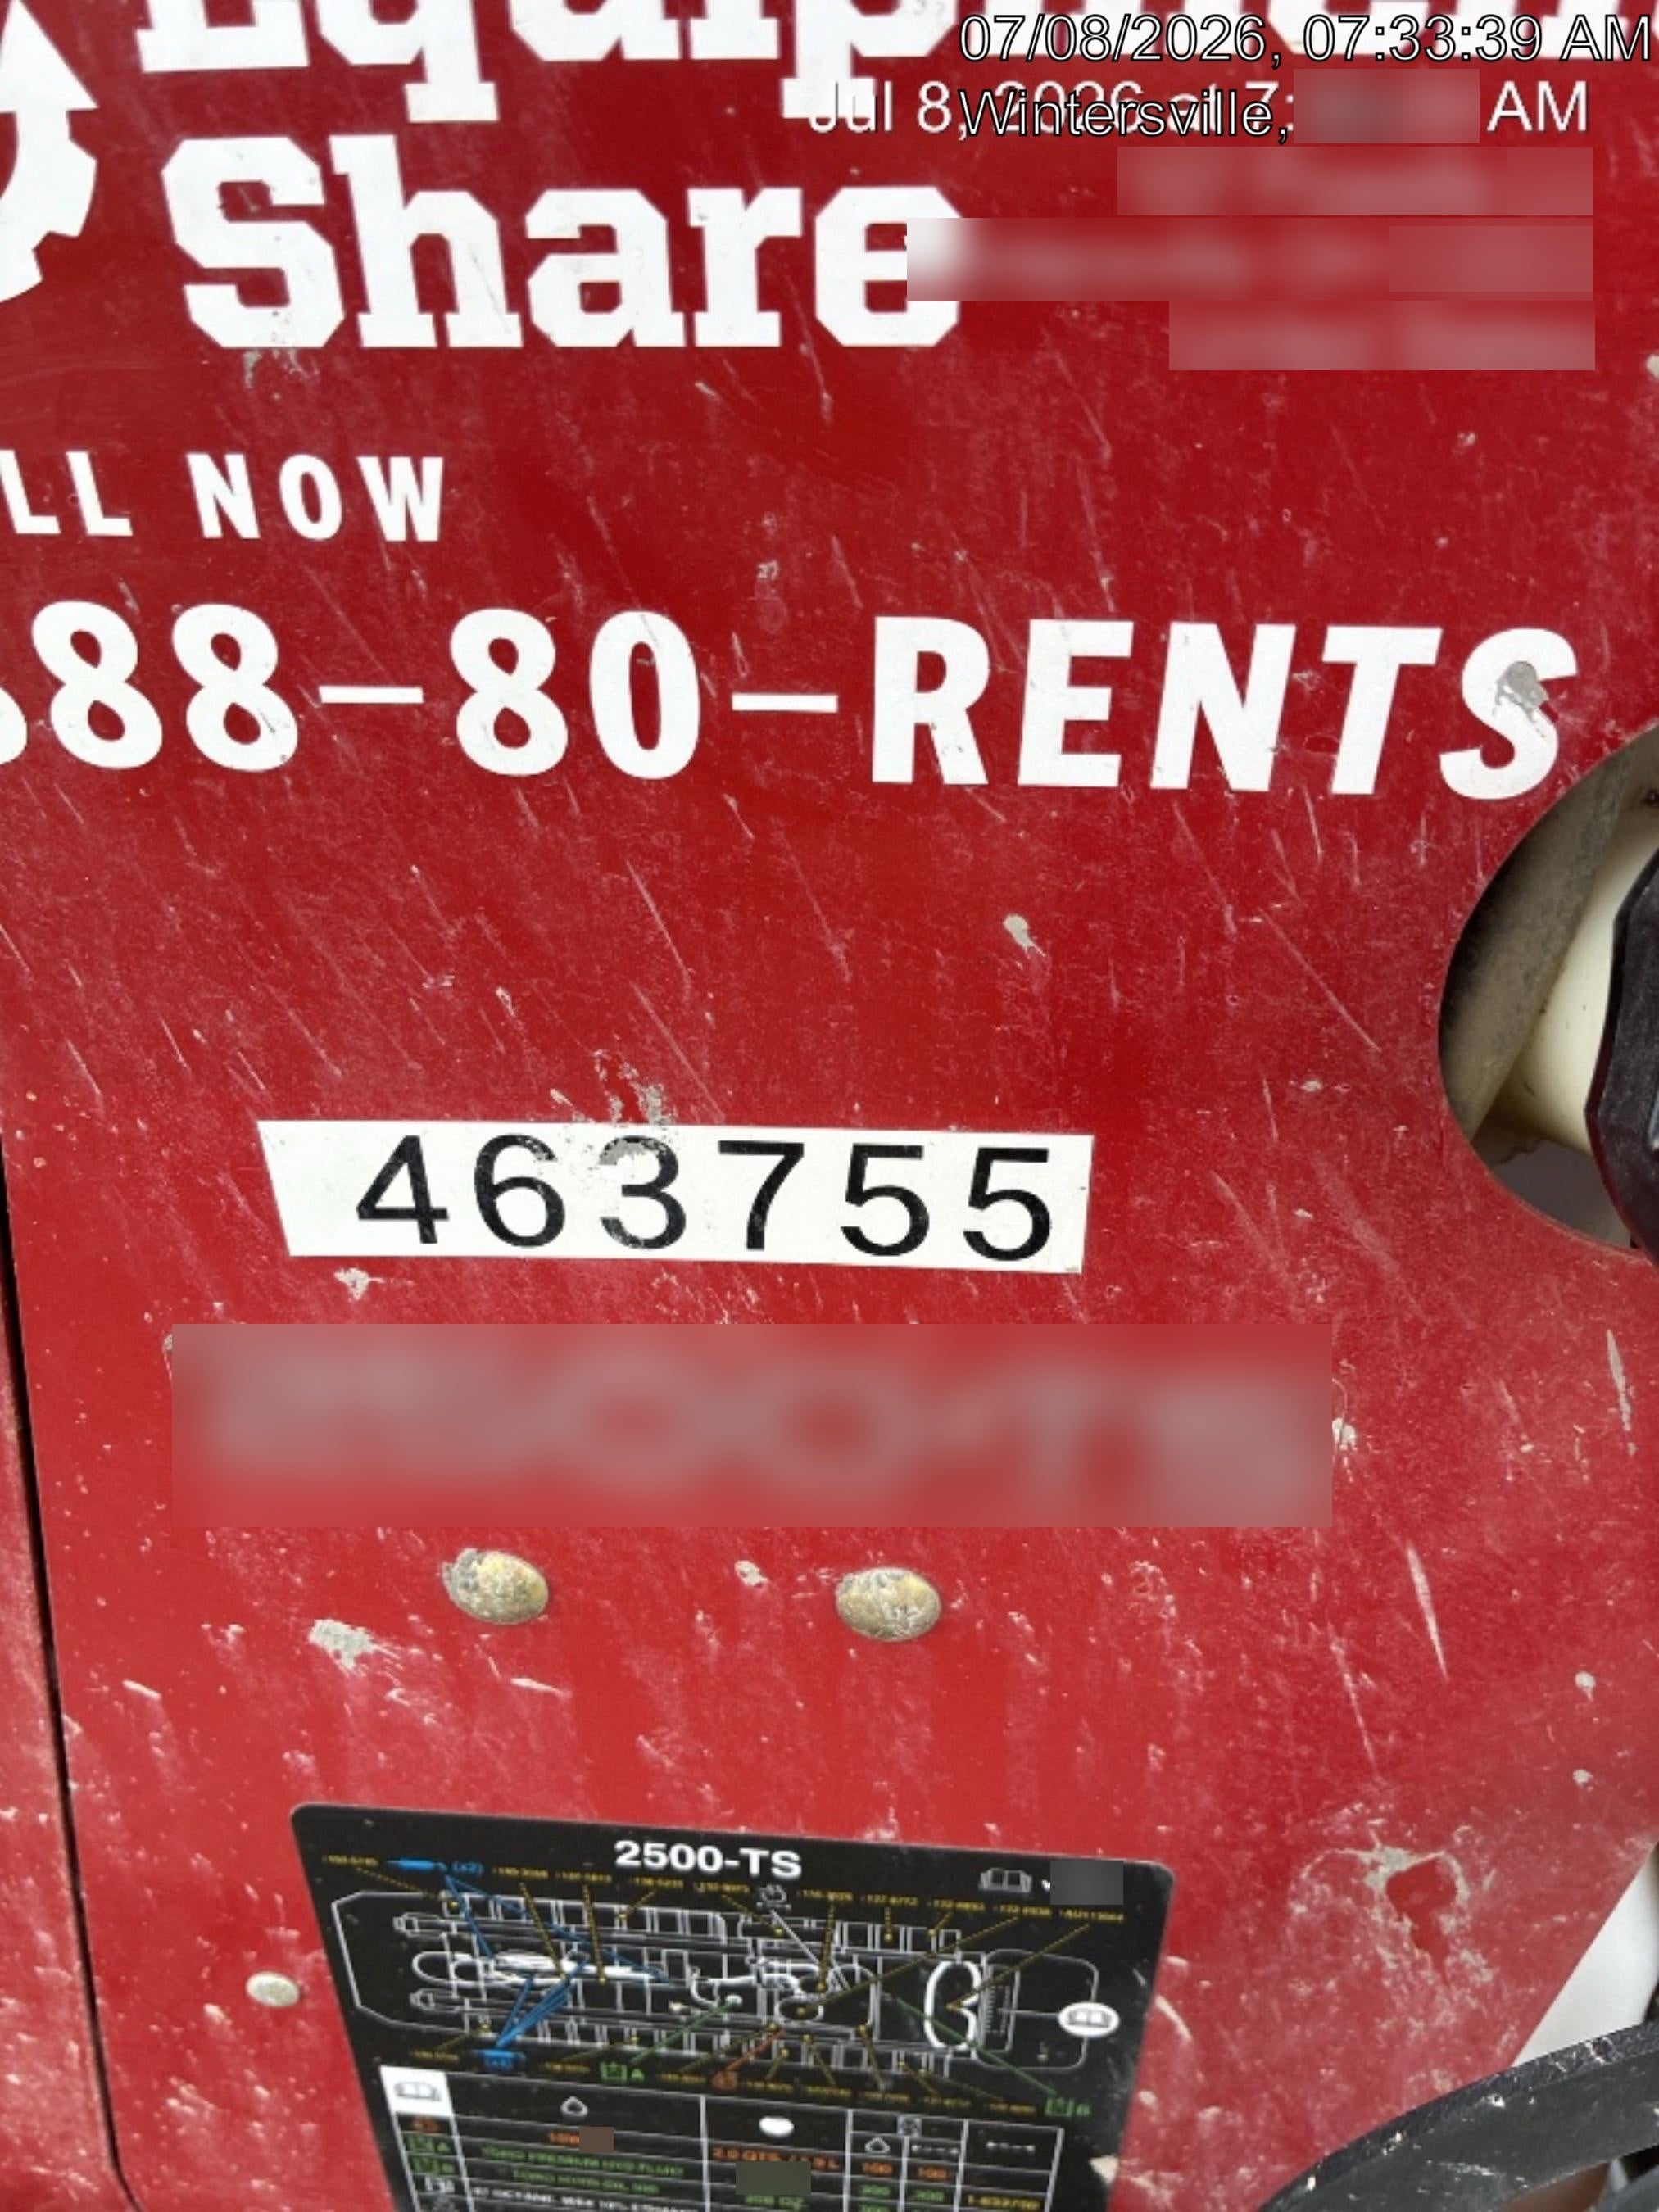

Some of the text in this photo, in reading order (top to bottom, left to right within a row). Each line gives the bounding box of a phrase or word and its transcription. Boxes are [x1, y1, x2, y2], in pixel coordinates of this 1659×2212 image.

[161, 134, 963, 348] Share
[185, 452, 444, 542] NOW
[0, 600, 1578, 800] 88-80-RENTS
[355, 1134, 1052, 1262] 463755
[614, 1838, 803, 1879] 2500-TS
